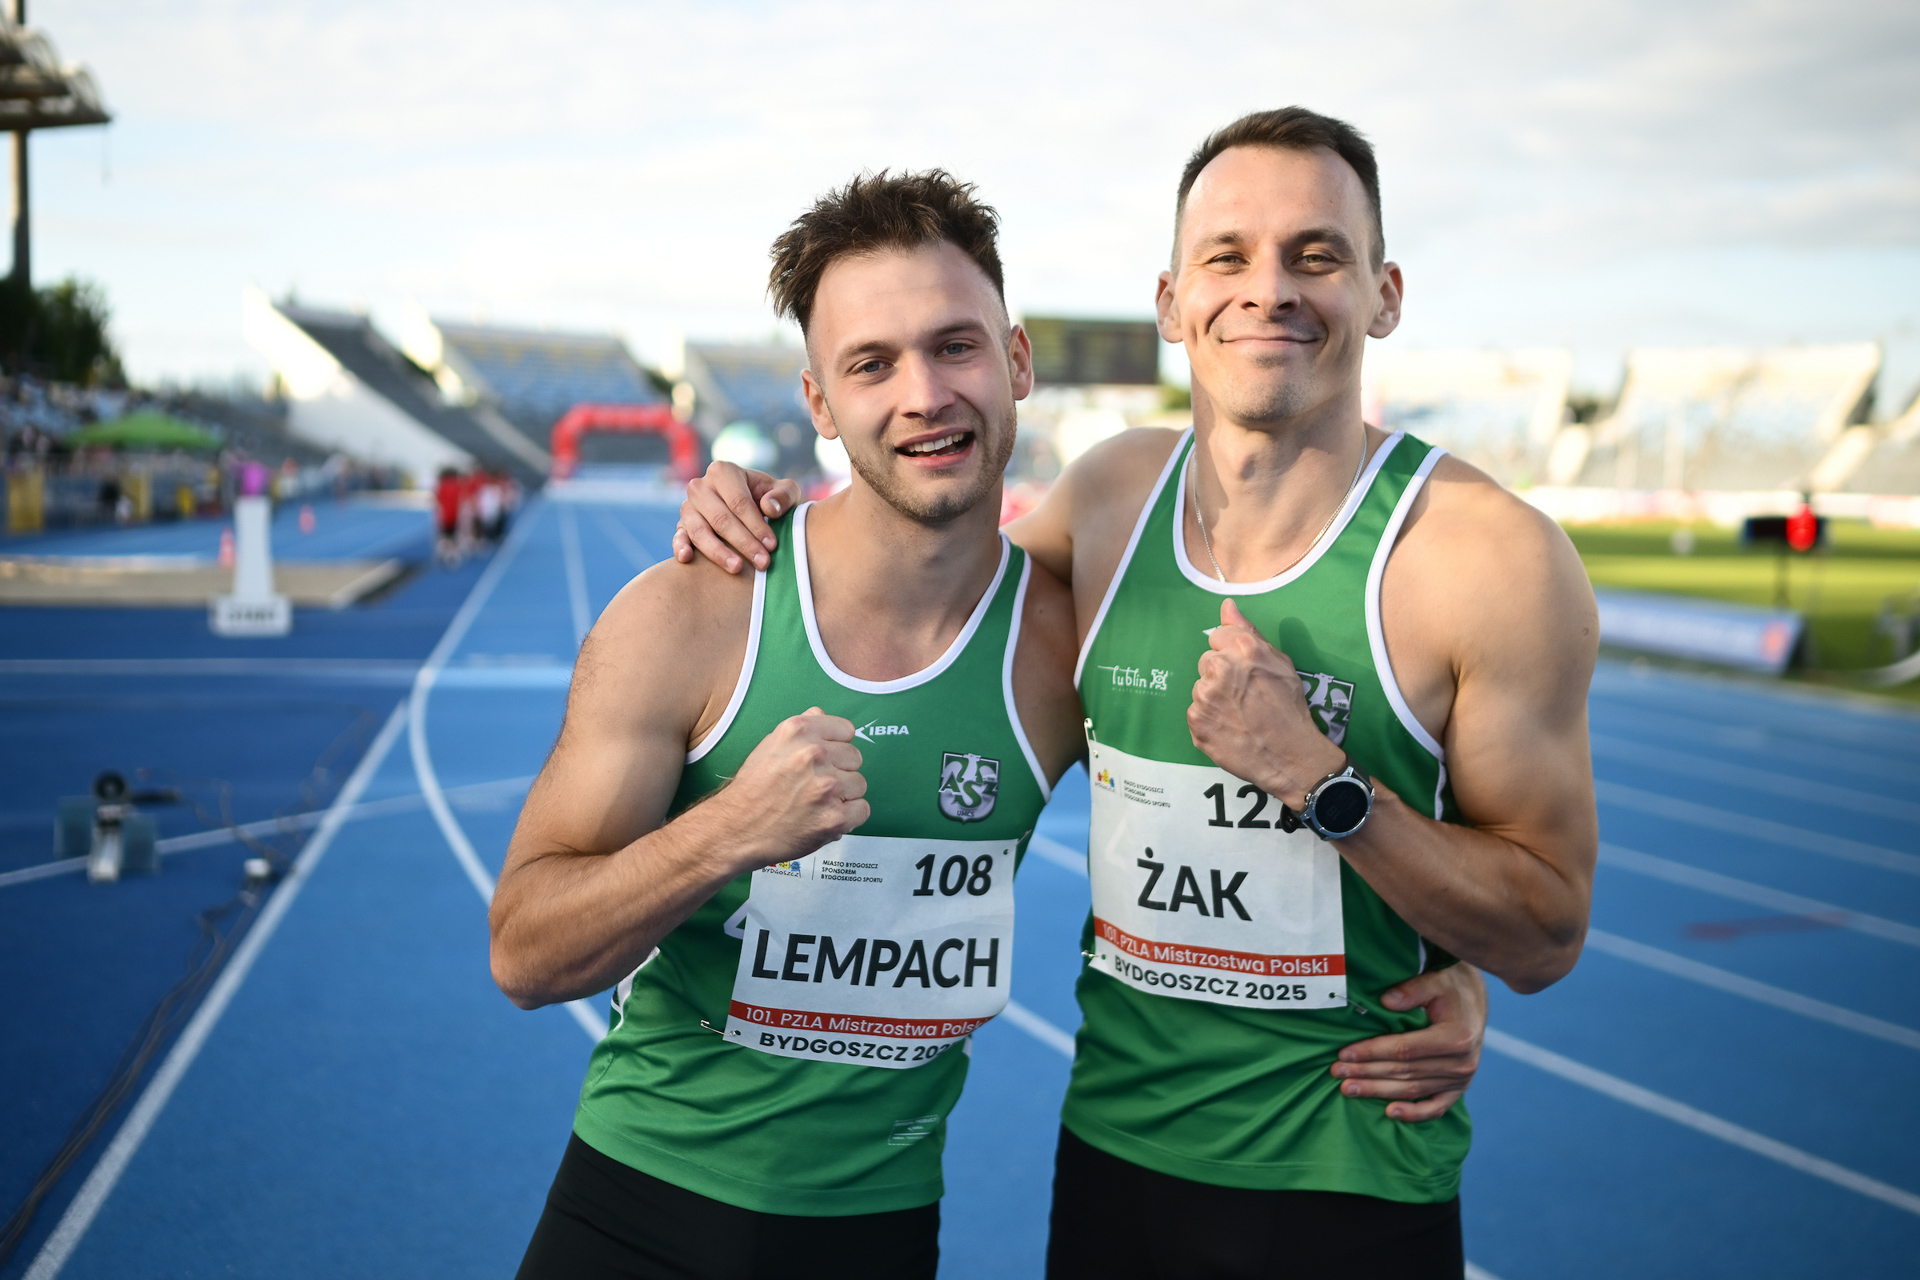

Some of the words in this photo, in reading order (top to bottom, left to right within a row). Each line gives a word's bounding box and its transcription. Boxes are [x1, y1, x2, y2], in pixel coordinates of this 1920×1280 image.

[1203, 783, 1308, 829] 12
[761, 867, 801, 878] BYDGOSZCZ
[821, 867, 857, 875] SPONSOREM
[821, 874, 865, 882] BYDGOSKIEGO
[822, 860, 845, 868] MIASTO
[845, 861, 878, 869] BYDGOSZCZ
[912, 854, 993, 896] 108
[1137, 847, 1253, 921] ŻAK
[751, 929, 999, 988] LEMPACH
[1103, 923, 1119, 945] 101.
[1120, 934, 1150, 959] PZLA
[1154, 946, 1265, 973] Mistrzostwa
[1270, 958, 1329, 975] Polski
[1115, 955, 1239, 997] BYDGOSZCZ
[1244, 982, 1307, 1001] 2025
[745, 1007, 774, 1025] 101.
[780, 1013, 823, 1029] PZLA
[828, 1017, 937, 1036] Mistrzostwa
[759, 1032, 909, 1061] BYDGOSZCZ
[912, 1042, 957, 1061] 202
